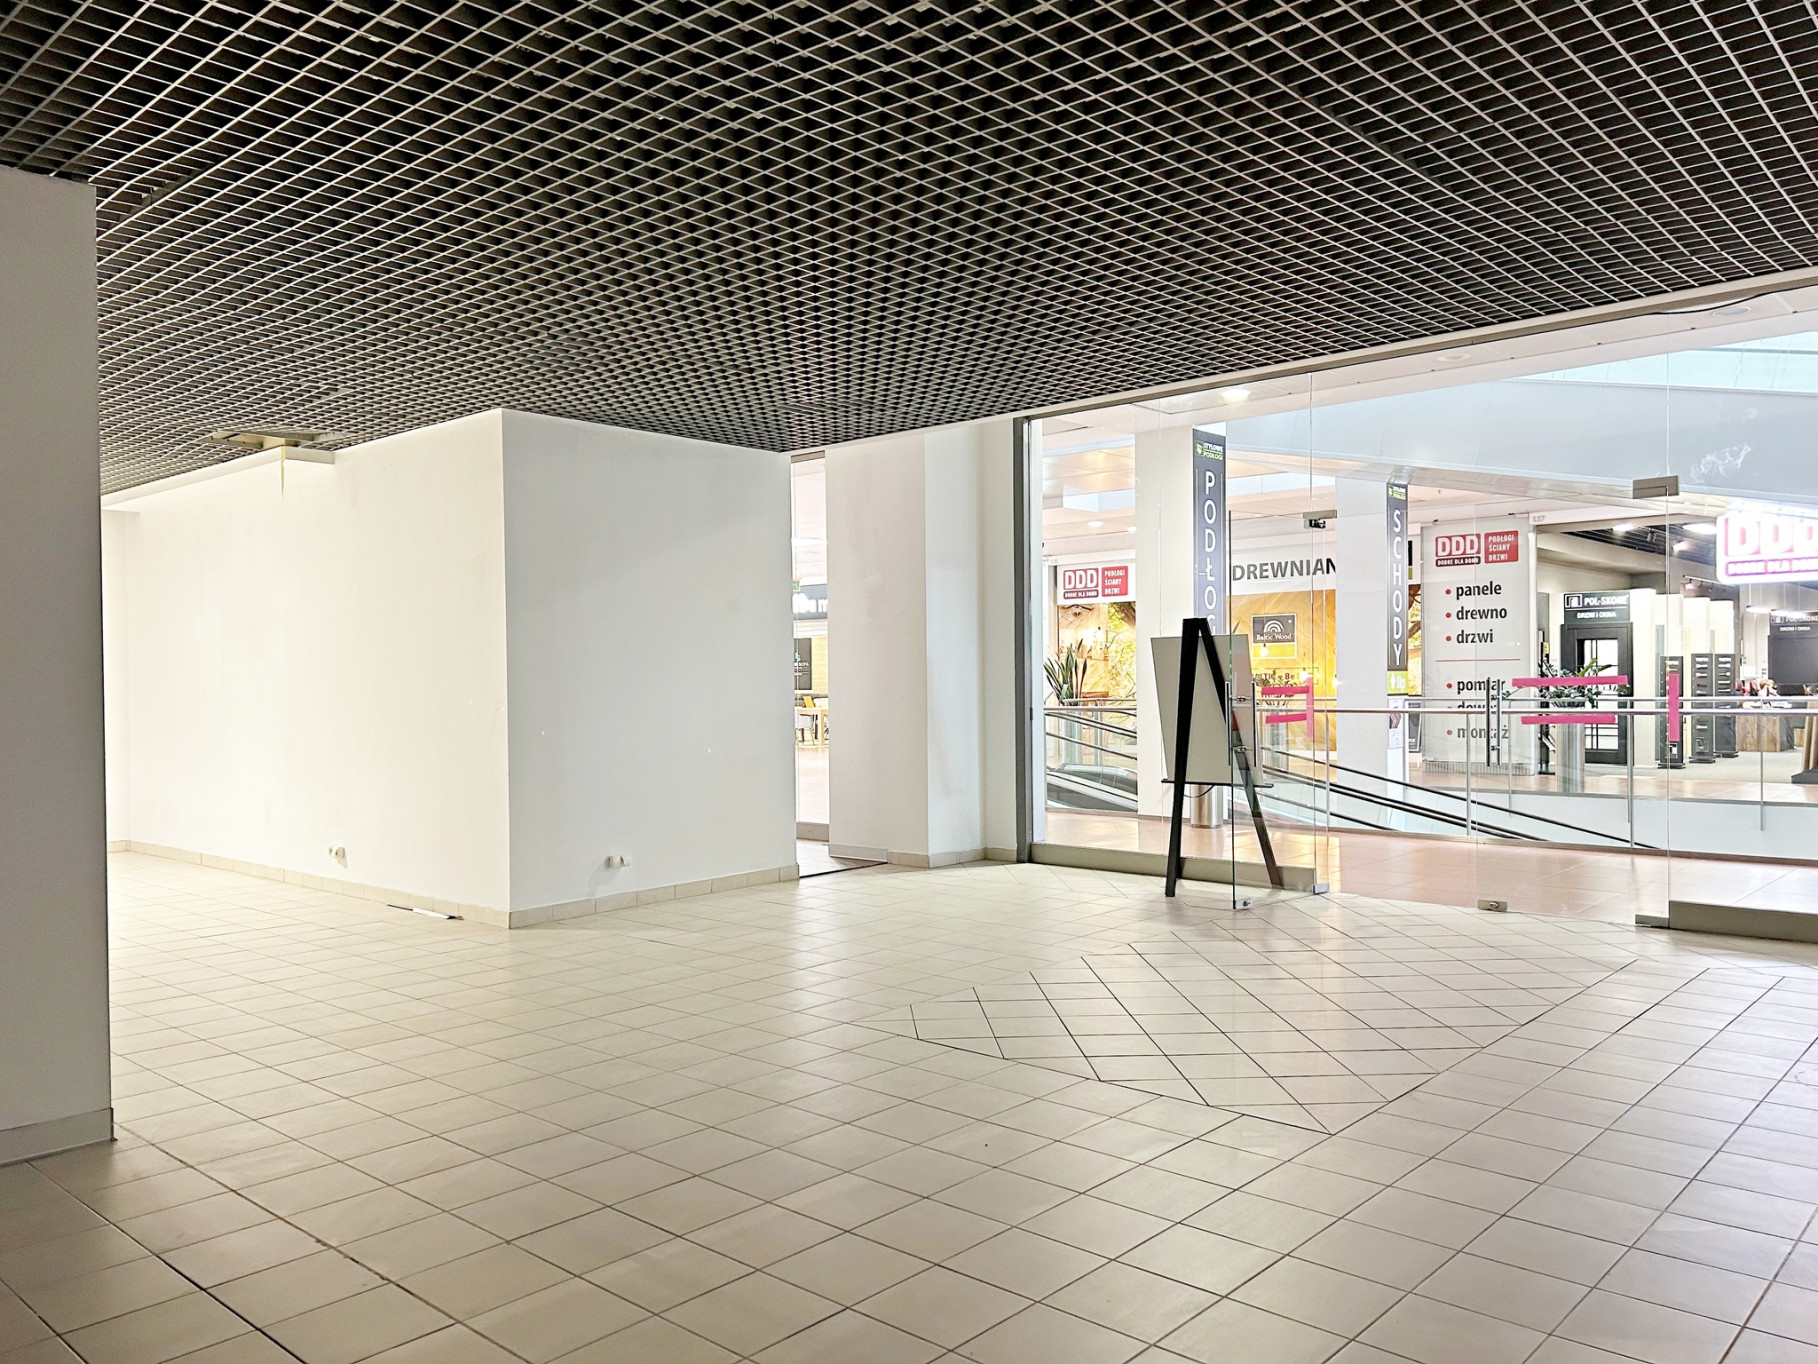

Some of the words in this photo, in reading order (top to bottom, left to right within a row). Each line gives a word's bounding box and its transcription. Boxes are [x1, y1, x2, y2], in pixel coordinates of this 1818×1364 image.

[1488, 534, 1514, 542] PODŁOGI
[1437, 535, 1479, 556] DDD
[1488, 544, 1510, 552] ŚCIANY
[1488, 553, 1508, 561] DRZWI
[1064, 569, 1098, 589] DDD
[1392, 509, 1403, 666] SCHODY
[1456, 581, 1502, 600] panele
[1456, 606, 1508, 620] drewno
[1274, 632, 1292, 640] Wood
[1456, 629, 1493, 644] drzwi
